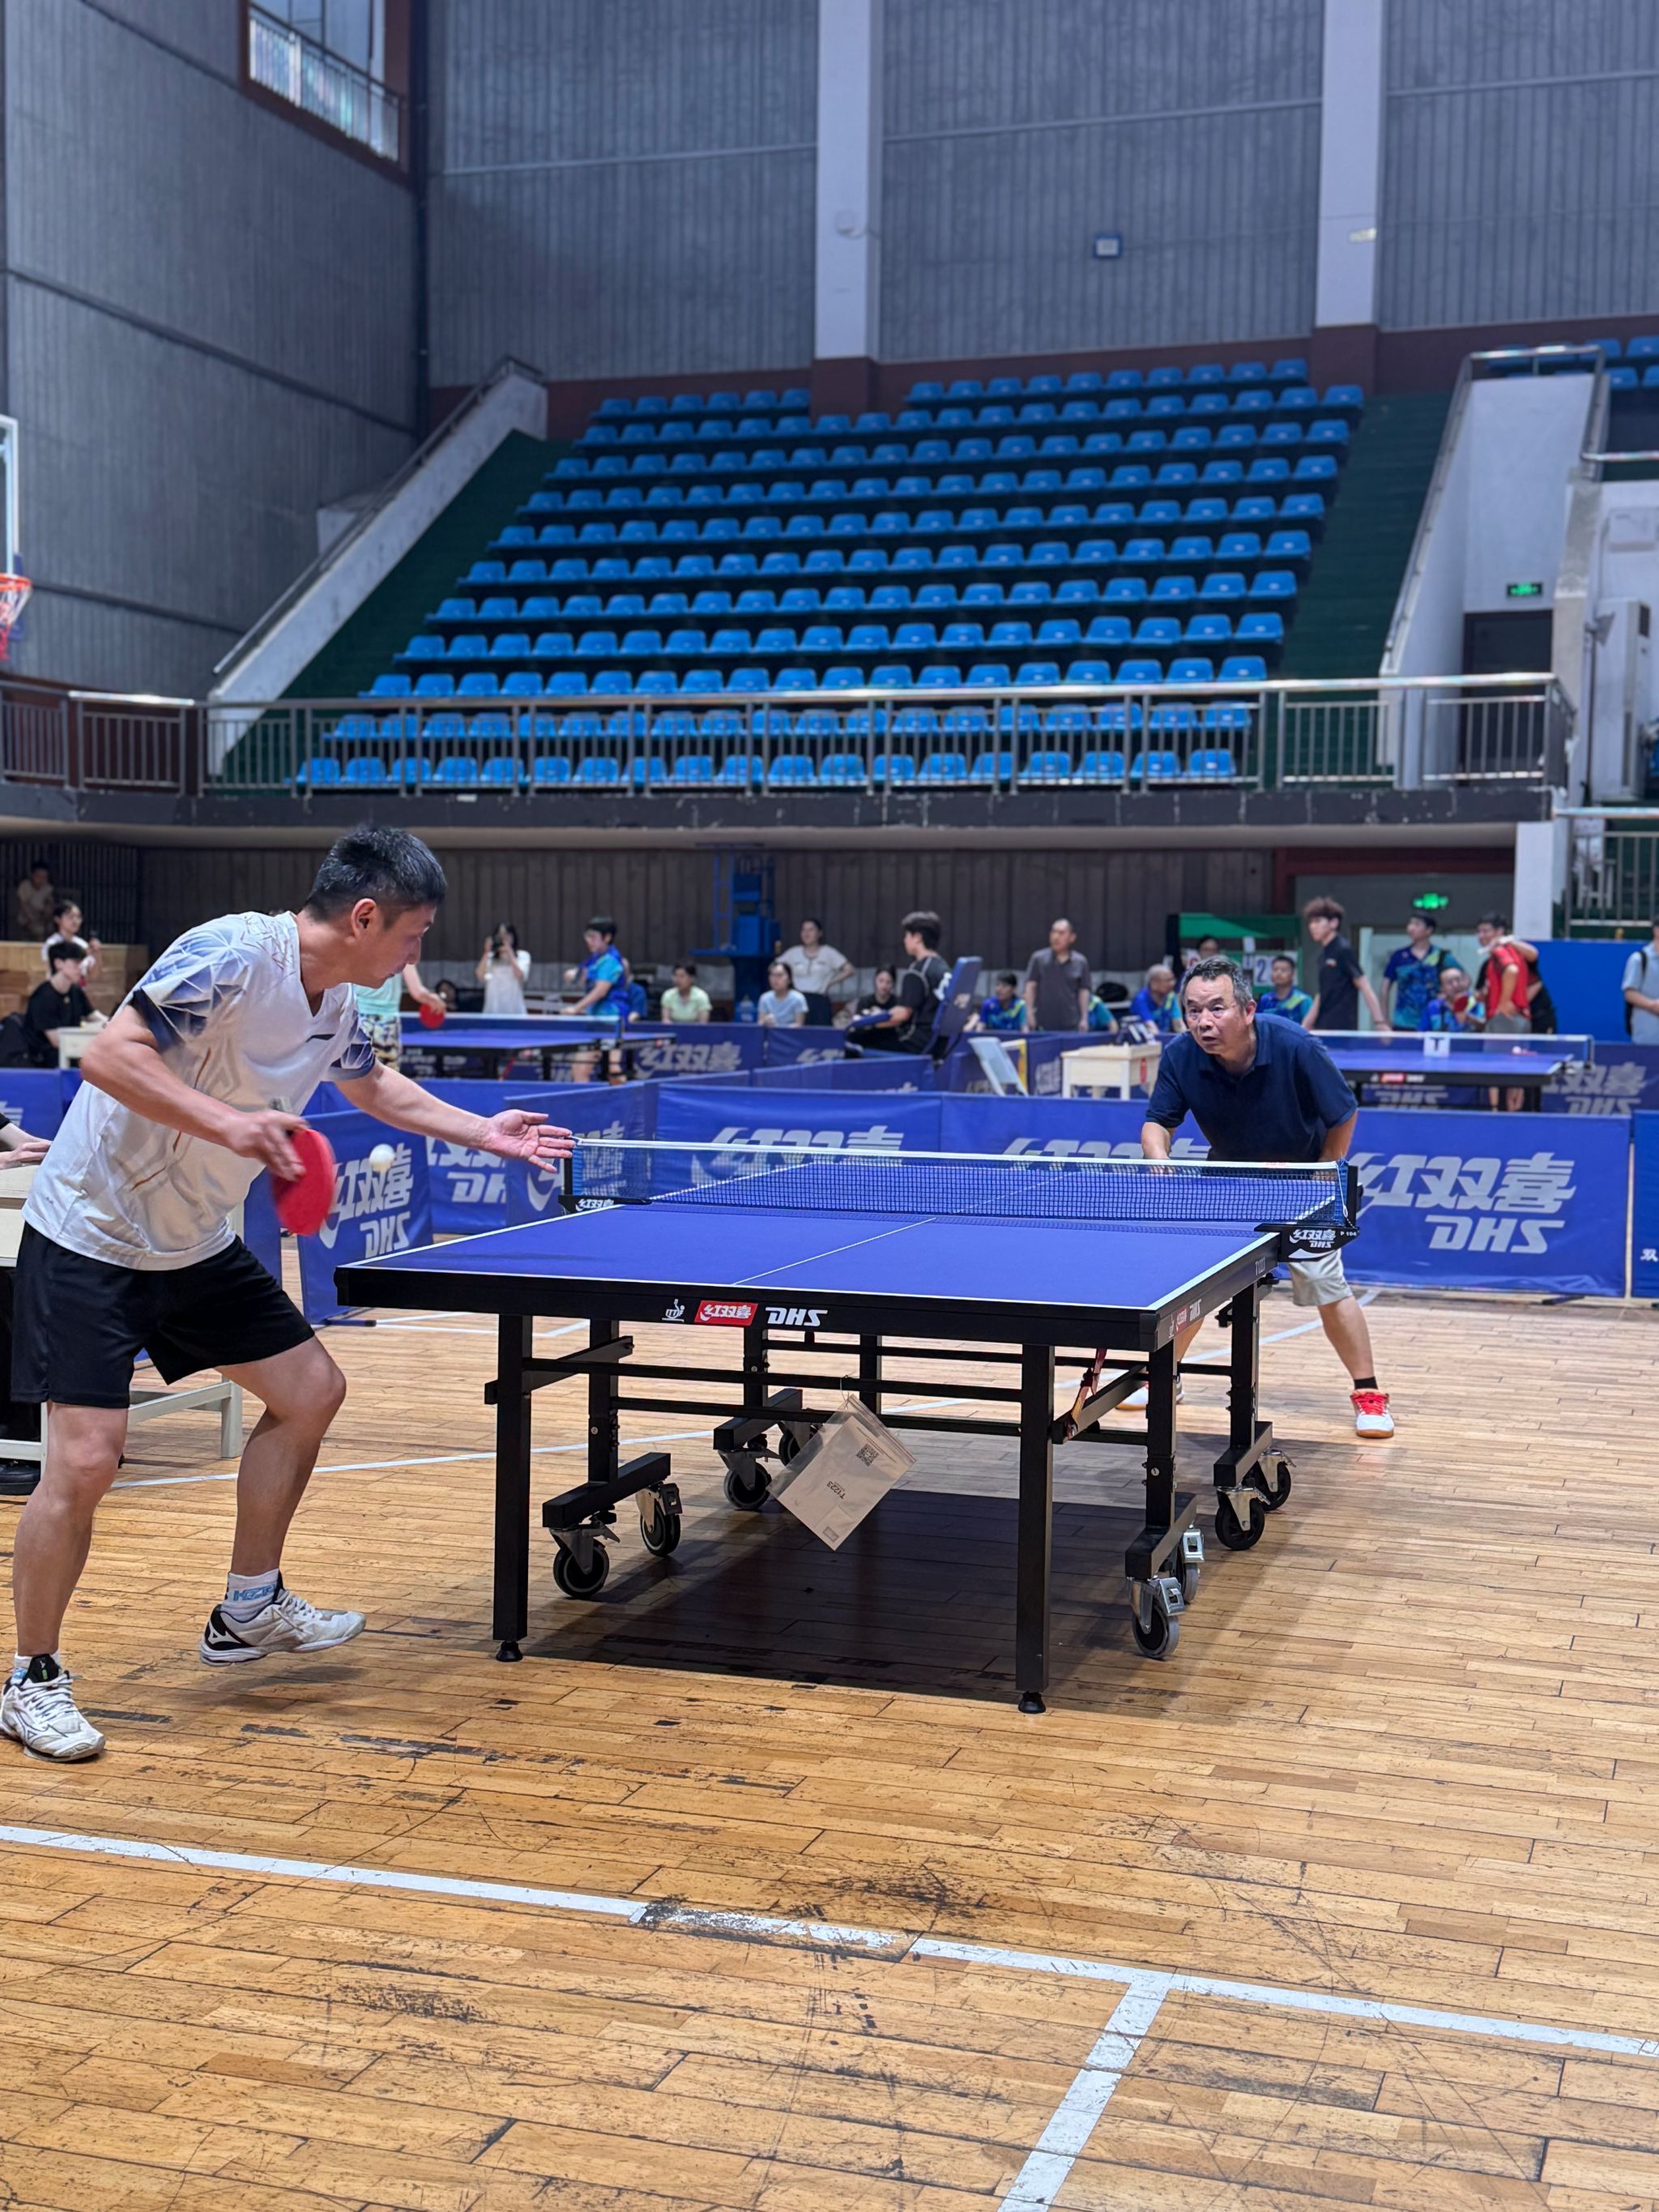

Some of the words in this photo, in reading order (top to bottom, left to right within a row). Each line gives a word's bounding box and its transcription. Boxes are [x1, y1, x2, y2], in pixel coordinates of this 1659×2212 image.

[1347, 1152, 1577, 1214] 红双喜
[360, 1211, 412, 1259] DHS
[1292, 1228, 1337, 1241] 红双喜
[1309, 1240, 1335, 1248] DHS
[1424, 1215, 1566, 1254] DHS
[703, 1304, 752, 1319] 红双喜
[765, 1306, 829, 1327] DHS
[826, 1480, 846, 1500] T1223
